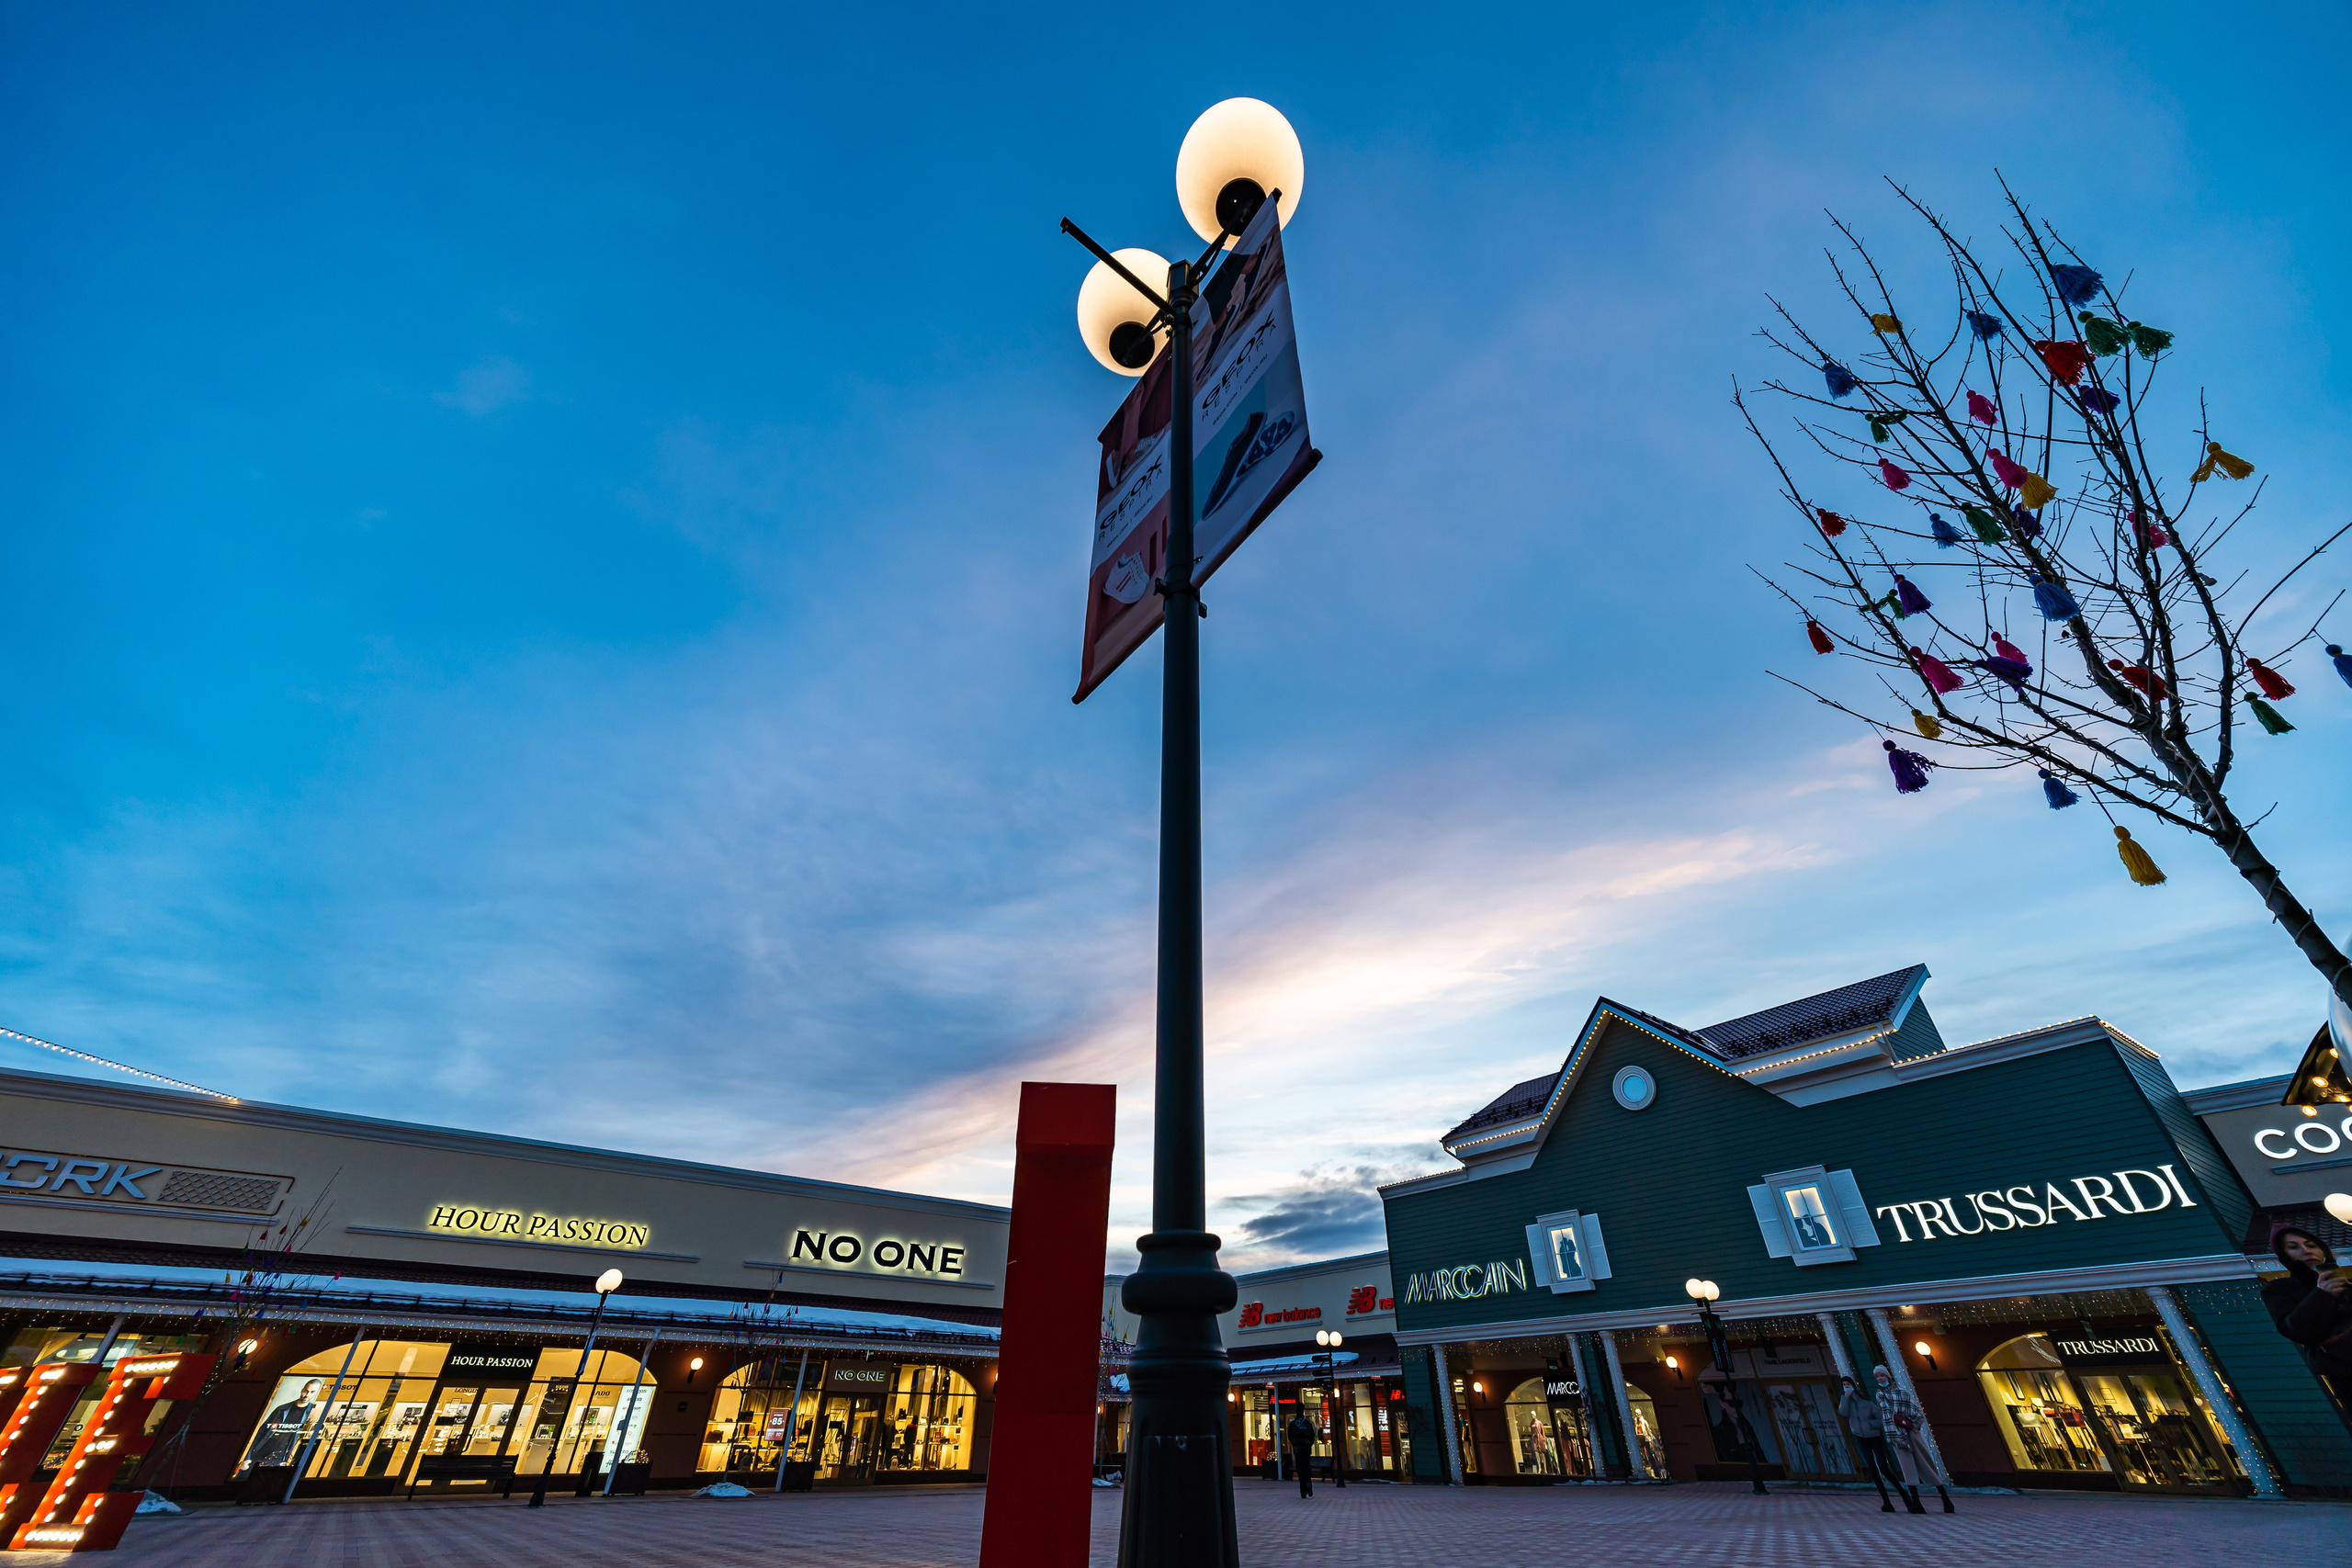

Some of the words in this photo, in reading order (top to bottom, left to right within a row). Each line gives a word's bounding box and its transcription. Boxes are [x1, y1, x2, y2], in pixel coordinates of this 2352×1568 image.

[1202, 309, 1275, 410] GEOX
[1202, 324, 1276, 422] RESPIRA
[1099, 468, 1162, 542] RESPIRA
[1100, 453, 1162, 530] GEOX
[2254, 1116, 2352, 1159] CO
[0, 1152, 163, 1200] ORK
[429, 1206, 521, 1235] HOUR
[526, 1215, 649, 1246] PASSION
[1876, 1164, 2198, 1243] TRUSSARDI
[790, 1229, 862, 1264] NO
[873, 1240, 966, 1277] ONE
[1263, 1312, 1283, 1324] new
[1283, 1306, 1321, 1323] balance
[450, 1356, 484, 1366] HOUR
[485, 1357, 534, 1368] PASSION
[2057, 1337, 2160, 1355] TRUSSARDI
[834, 1370, 855, 1381] NO
[856, 1371, 886, 1382] ONE
[1546, 1381, 1580, 1395] MARCC
